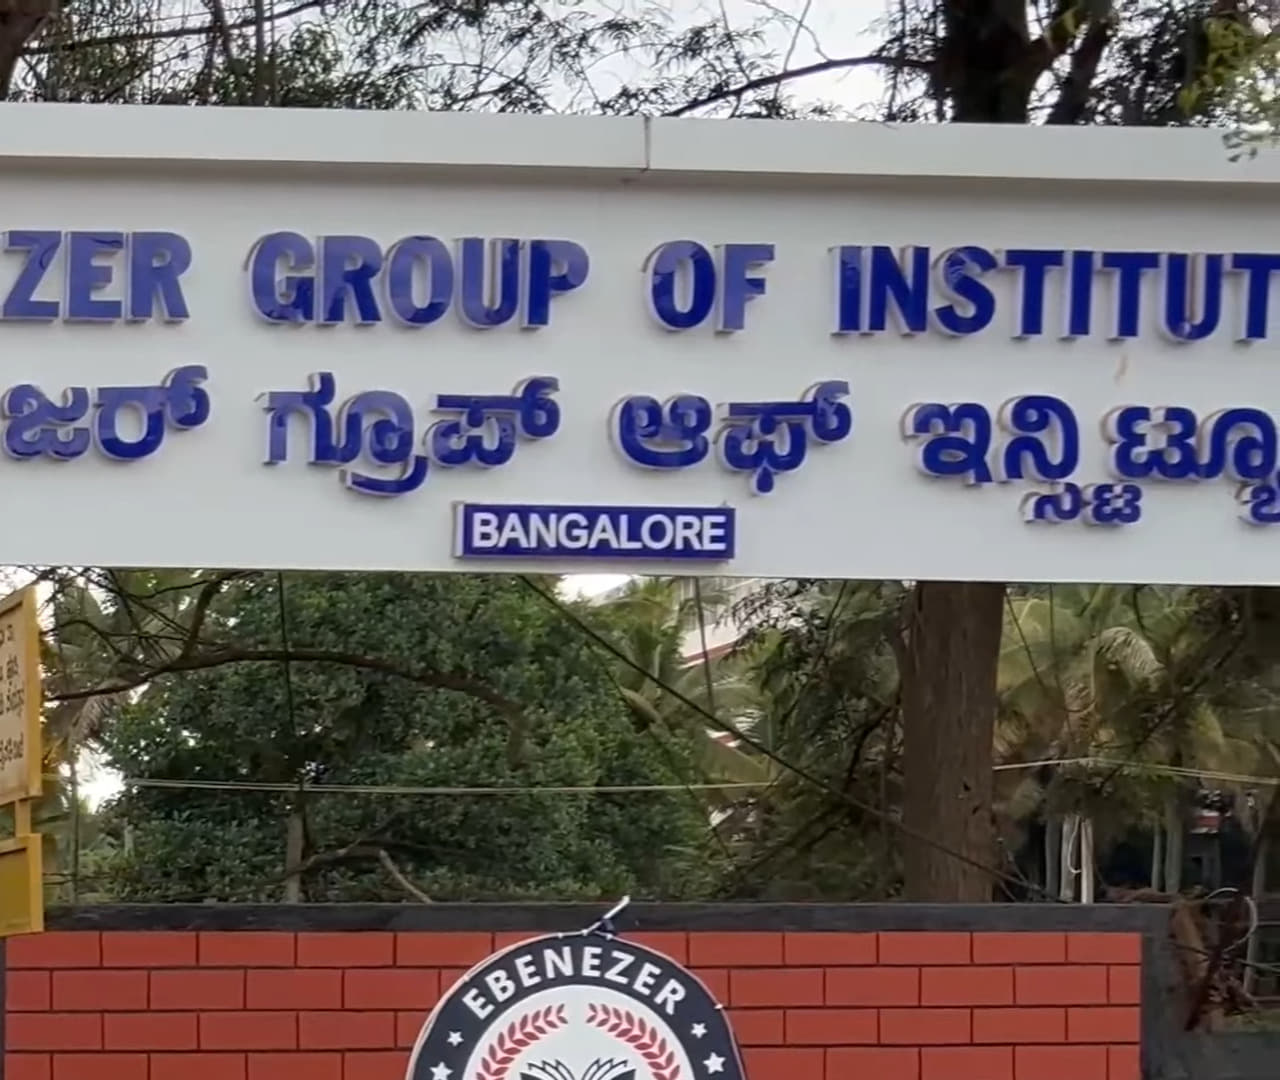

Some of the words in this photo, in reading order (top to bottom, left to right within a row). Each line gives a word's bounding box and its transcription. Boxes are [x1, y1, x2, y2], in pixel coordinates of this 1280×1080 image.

[246, 230, 590, 329] GROUP
[644, 239, 776, 333] OF
[470, 511, 727, 551] BANGALORE
[461, 946, 687, 1020] EBENEZER
